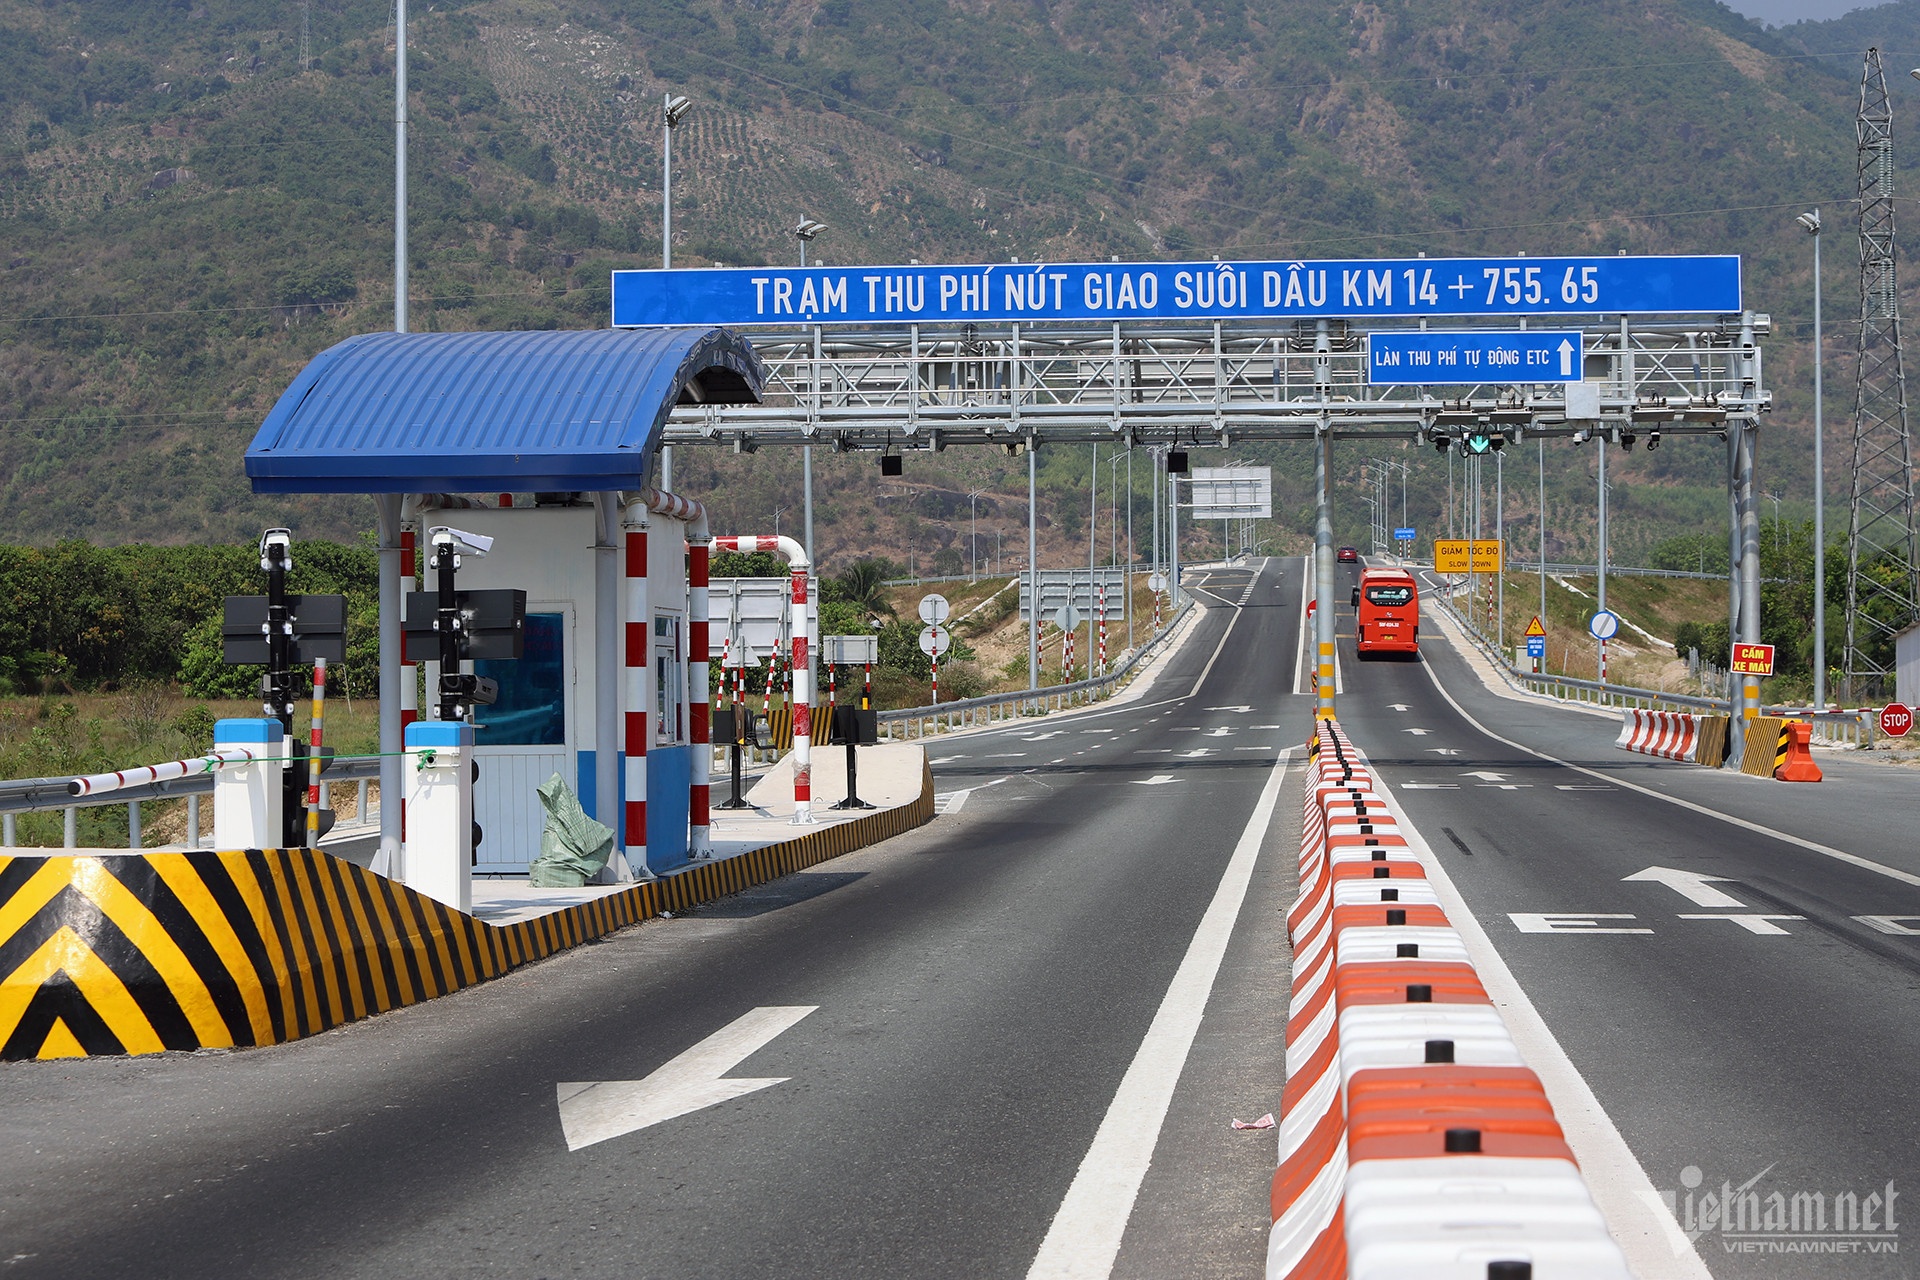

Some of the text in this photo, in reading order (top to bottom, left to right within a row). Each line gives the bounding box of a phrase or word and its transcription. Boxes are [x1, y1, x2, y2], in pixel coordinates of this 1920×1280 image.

[751, 276, 847, 320] TRẠM
[863, 275, 925, 313] THU
[940, 266, 995, 312] PHÍ
[1005, 265, 1068, 311] NÚT
[1083, 272, 1158, 310] GIAO
[1174, 263, 1247, 309] SUỐI
[1263, 262, 1327, 308] DẦU
[1342, 269, 1392, 307] KM
[1403, 268, 1439, 306] 14
[1561, 266, 1599, 304] 65
[1375, 345, 1550, 368] LÀN THU PHÍ TỰ ĐỘNG ETC
[1448, 560, 1492, 568] SLOW DOWN
[1741, 645, 1765, 660] CẤM
[1733, 660, 1771, 673] XE MÁY
[1883, 713, 1909, 727] STOP
